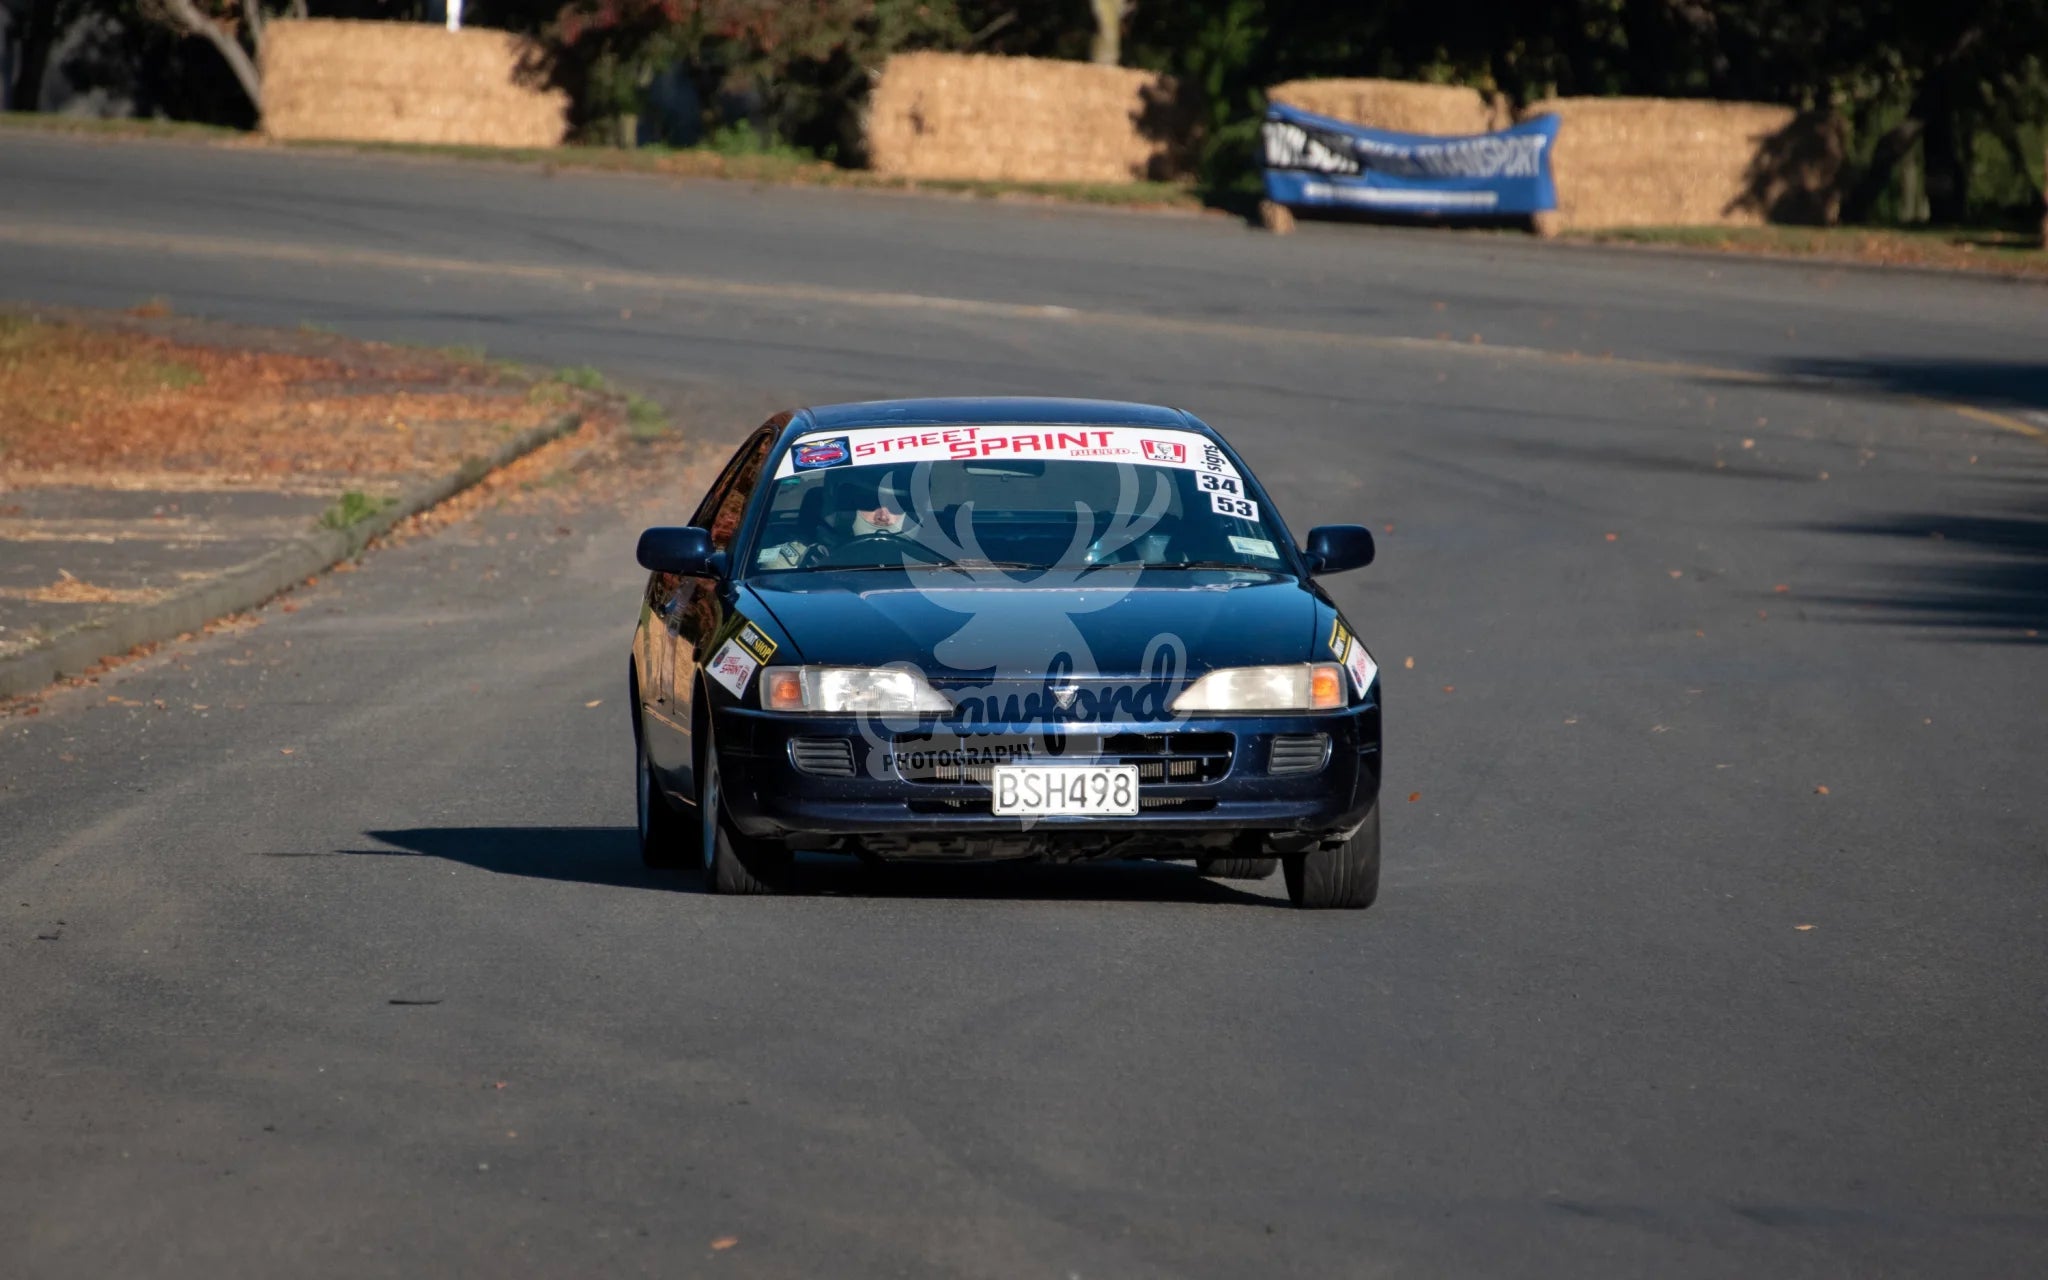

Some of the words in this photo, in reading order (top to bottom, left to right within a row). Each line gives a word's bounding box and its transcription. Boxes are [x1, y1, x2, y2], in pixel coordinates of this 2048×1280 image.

[1415, 134, 1548, 178] TRANSPORT
[855, 427, 980, 458] STREET
[949, 431, 1114, 460] SPRINT
[1201, 444, 1226, 473] signs
[1202, 475, 1238, 494] 34
[1217, 497, 1253, 517] 53
[998, 772, 1132, 808] BSH498
